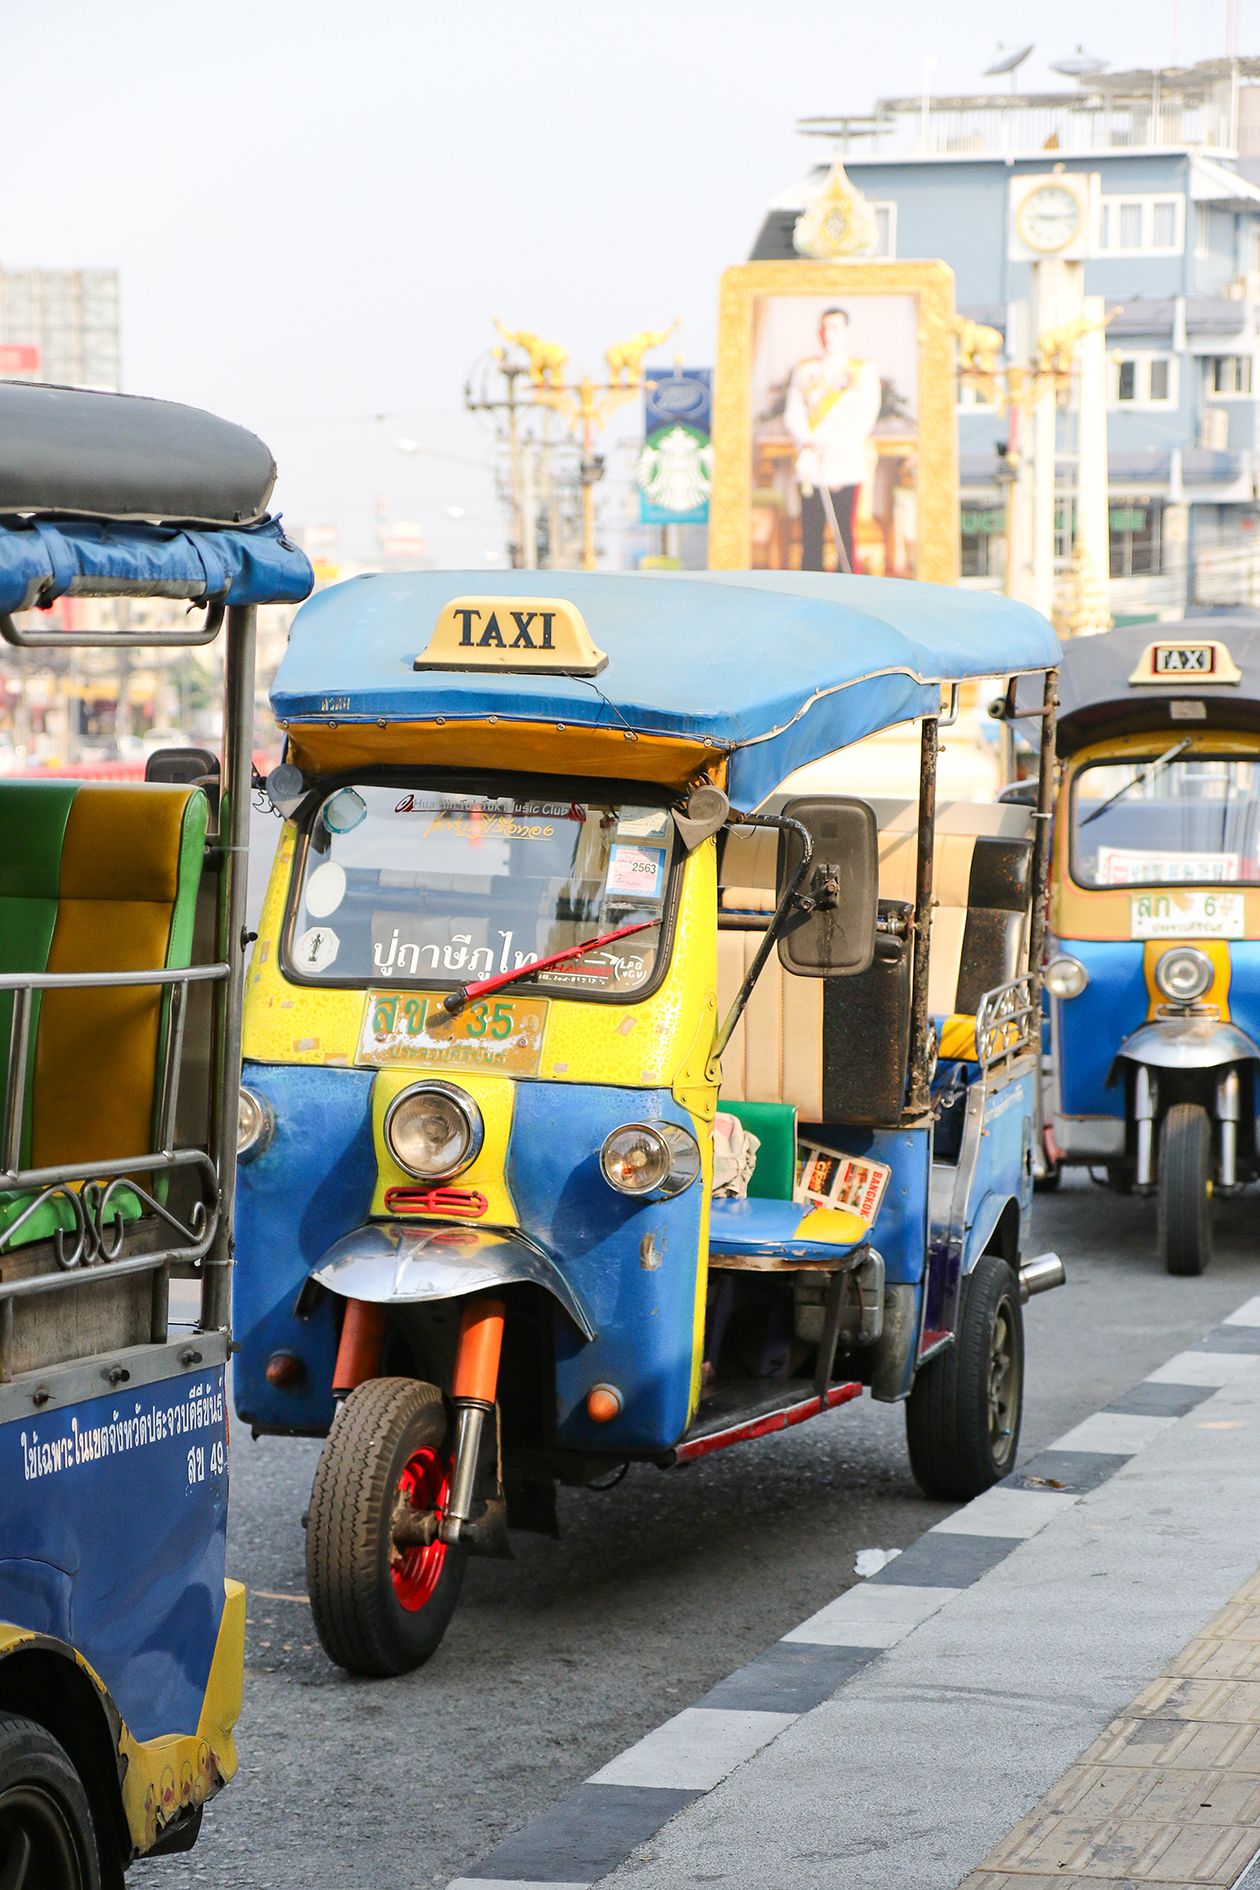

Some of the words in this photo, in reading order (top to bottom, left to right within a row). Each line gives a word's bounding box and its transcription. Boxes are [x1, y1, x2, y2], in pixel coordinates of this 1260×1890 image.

[454, 609, 556, 650] TAXI
[1160, 650, 1208, 669] TAXI
[414, 799, 435, 809] Hua
[459, 799, 478, 810] Tuk
[481, 800, 501, 811] Tuk
[503, 800, 539, 814] Music
[542, 803, 568, 816] Club
[632, 862, 656, 874] 2563
[620, 961, 643, 971] LPG
[372, 995, 428, 1034] สข
[860, 1171, 883, 1218] BANGKOK
[210, 1441, 224, 1476] 49
